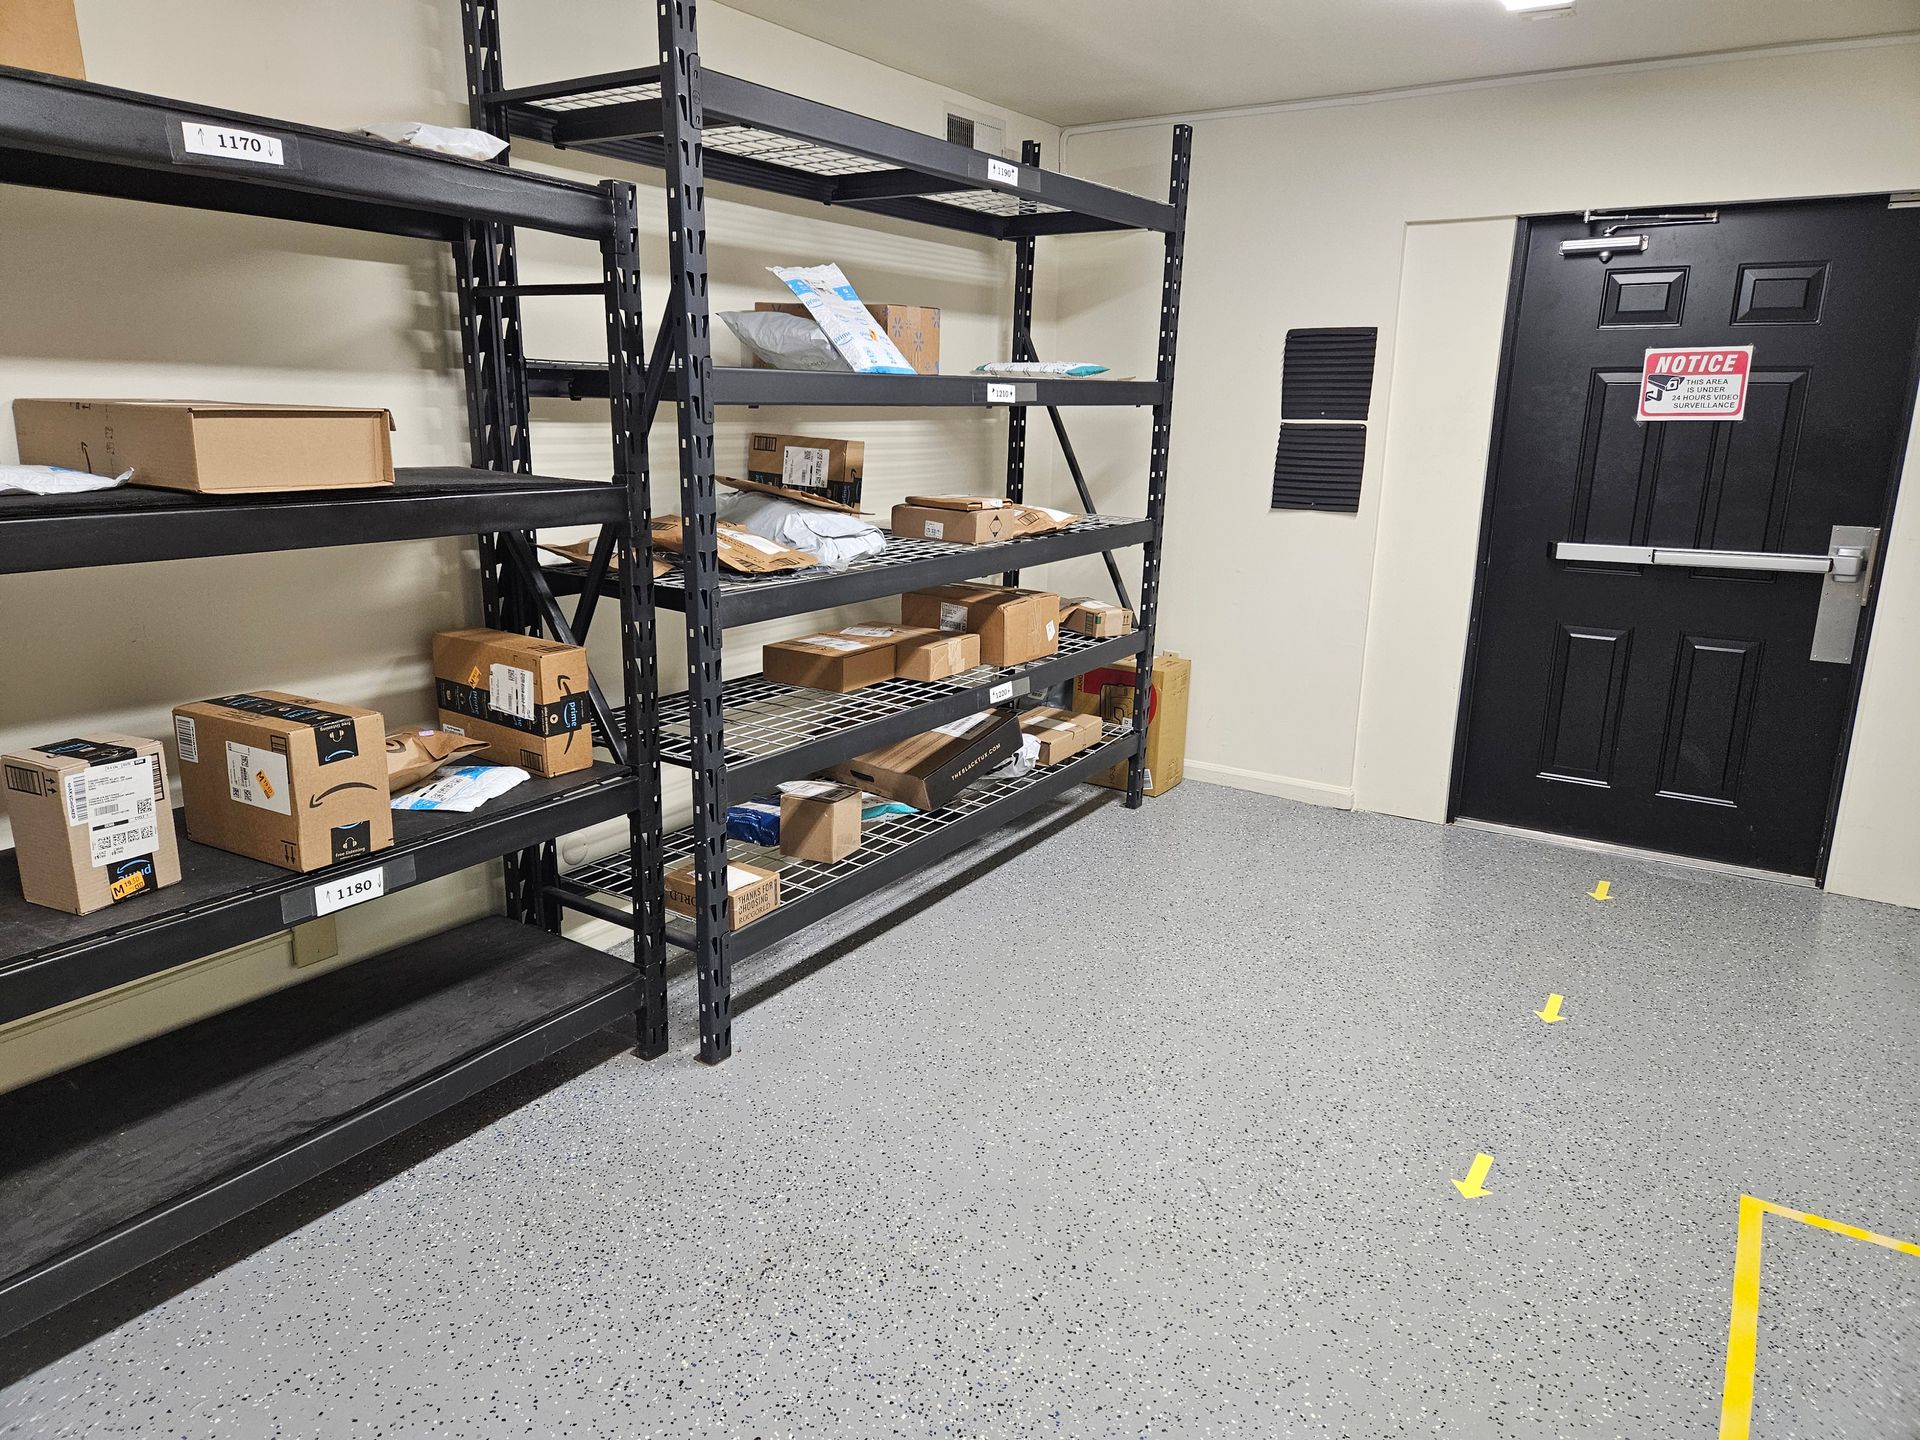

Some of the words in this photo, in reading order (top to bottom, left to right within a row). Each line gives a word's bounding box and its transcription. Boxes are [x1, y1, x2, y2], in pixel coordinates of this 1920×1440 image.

[218, 134, 261, 152] 1170
[997, 166, 1012, 178] 1190
[1655, 354, 1738, 374] NOTICE
[570, 701, 578, 727] prime
[113, 884, 125, 897] M
[337, 880, 372, 900] 1180
[738, 888, 761, 904] THANKS
[762, 881, 774, 892] FOR
[738, 893, 769, 915] CHOOSING
